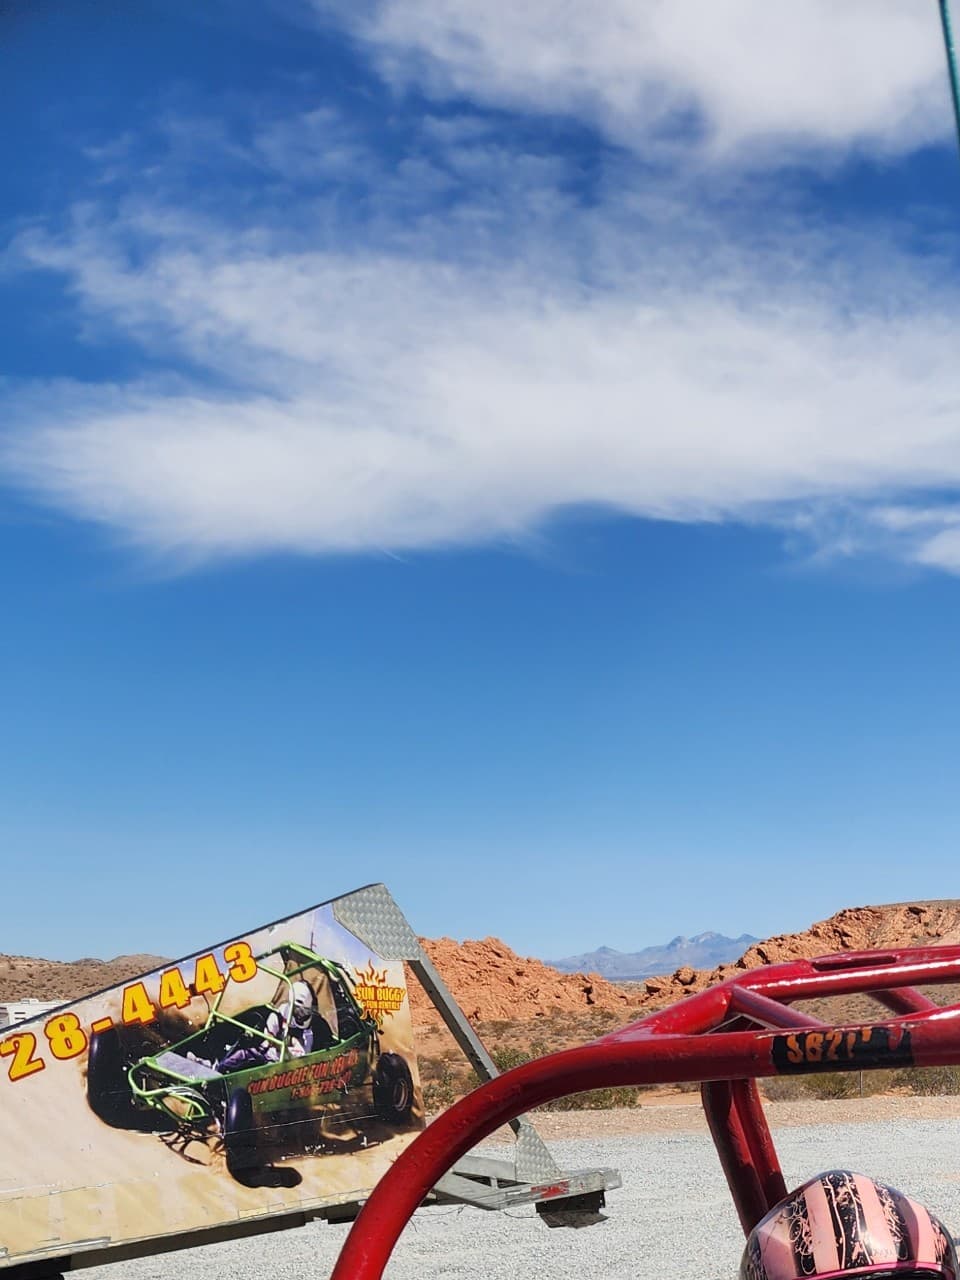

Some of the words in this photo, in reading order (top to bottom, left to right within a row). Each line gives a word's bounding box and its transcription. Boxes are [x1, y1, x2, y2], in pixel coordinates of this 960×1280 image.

[0, 942, 258, 1082] 28-4443
[356, 985, 375, 1001] SUN
[376, 986, 406, 1002] BUGGY
